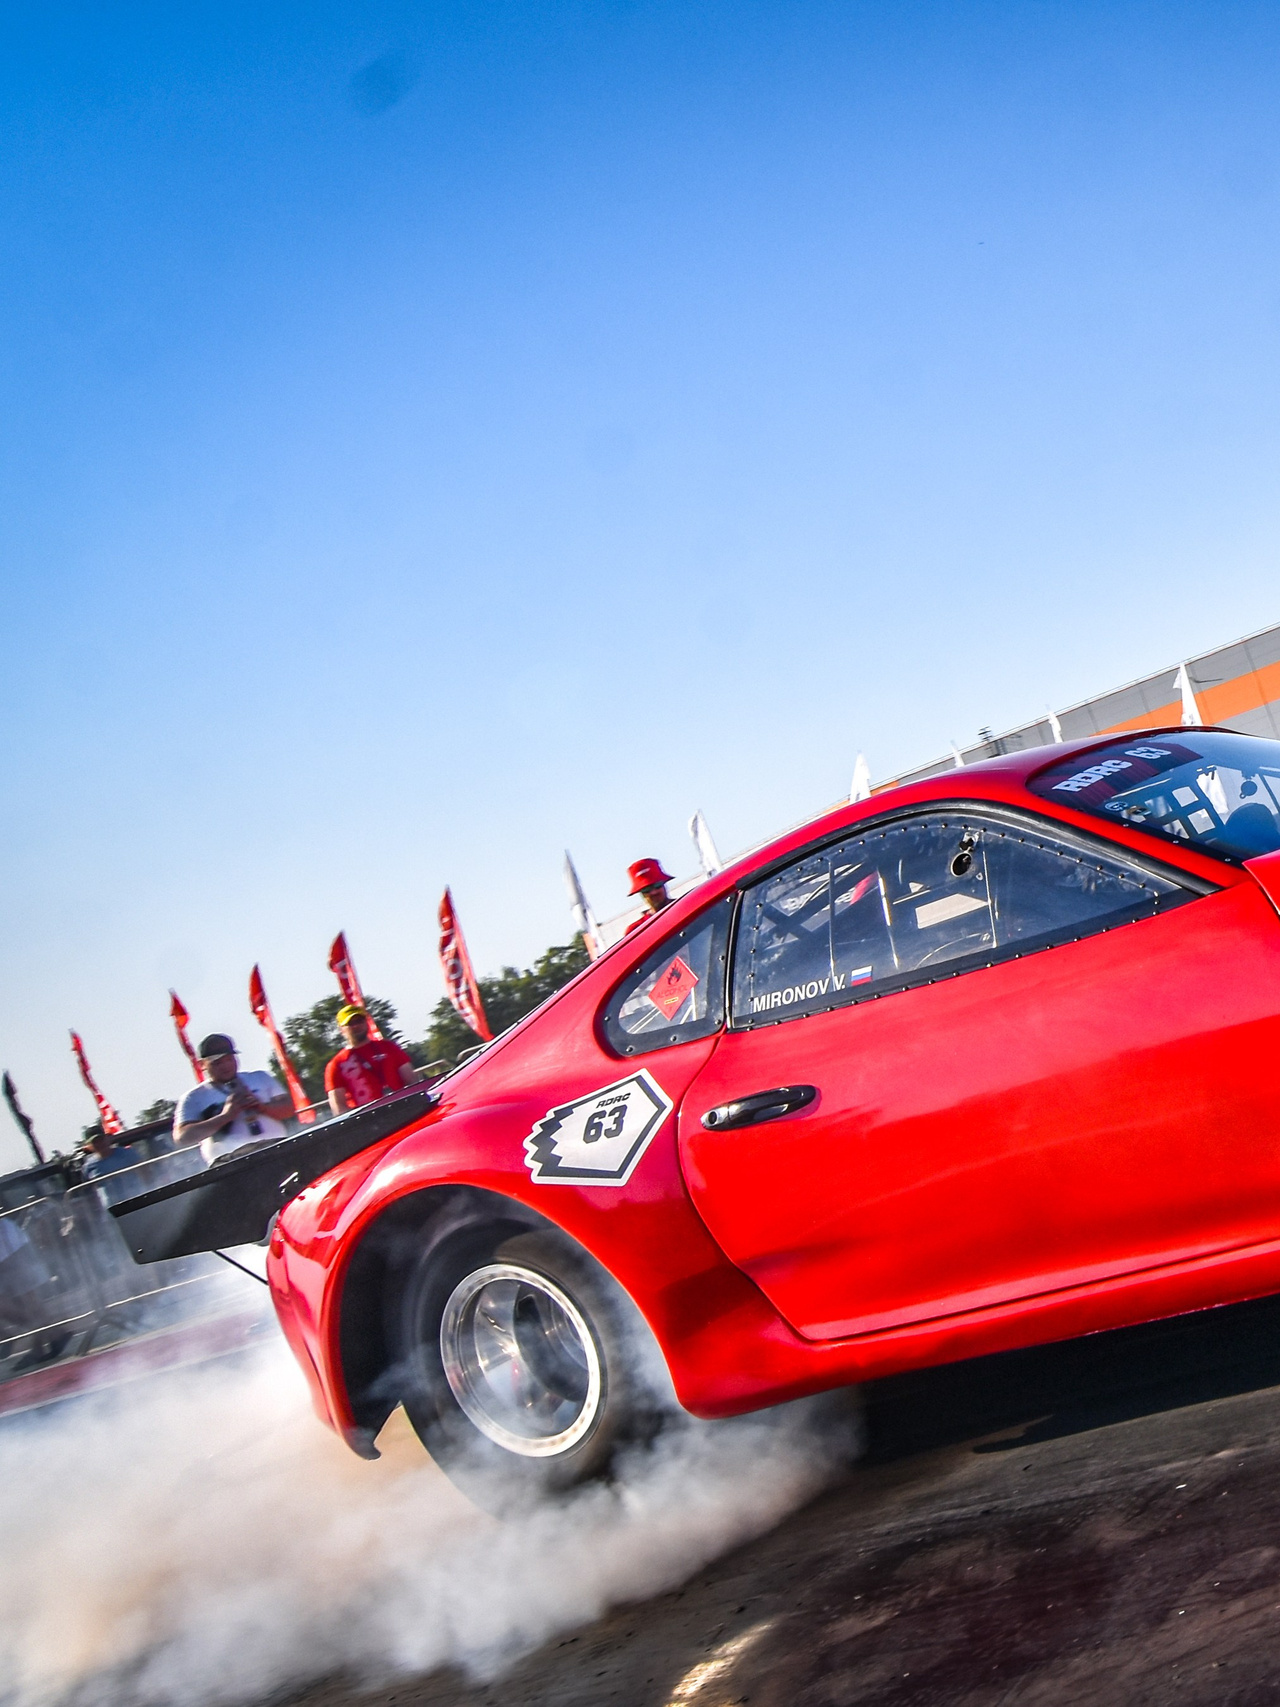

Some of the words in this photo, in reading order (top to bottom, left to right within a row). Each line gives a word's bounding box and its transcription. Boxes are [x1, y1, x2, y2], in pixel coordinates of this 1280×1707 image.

[1051, 759, 1133, 792] RDRC
[1124, 746, 1172, 760] 63
[753, 977, 830, 1013] MIRONOV
[833, 973, 846, 990] V.
[595, 1092, 631, 1109] RDRC
[582, 1104, 628, 1144] 63
